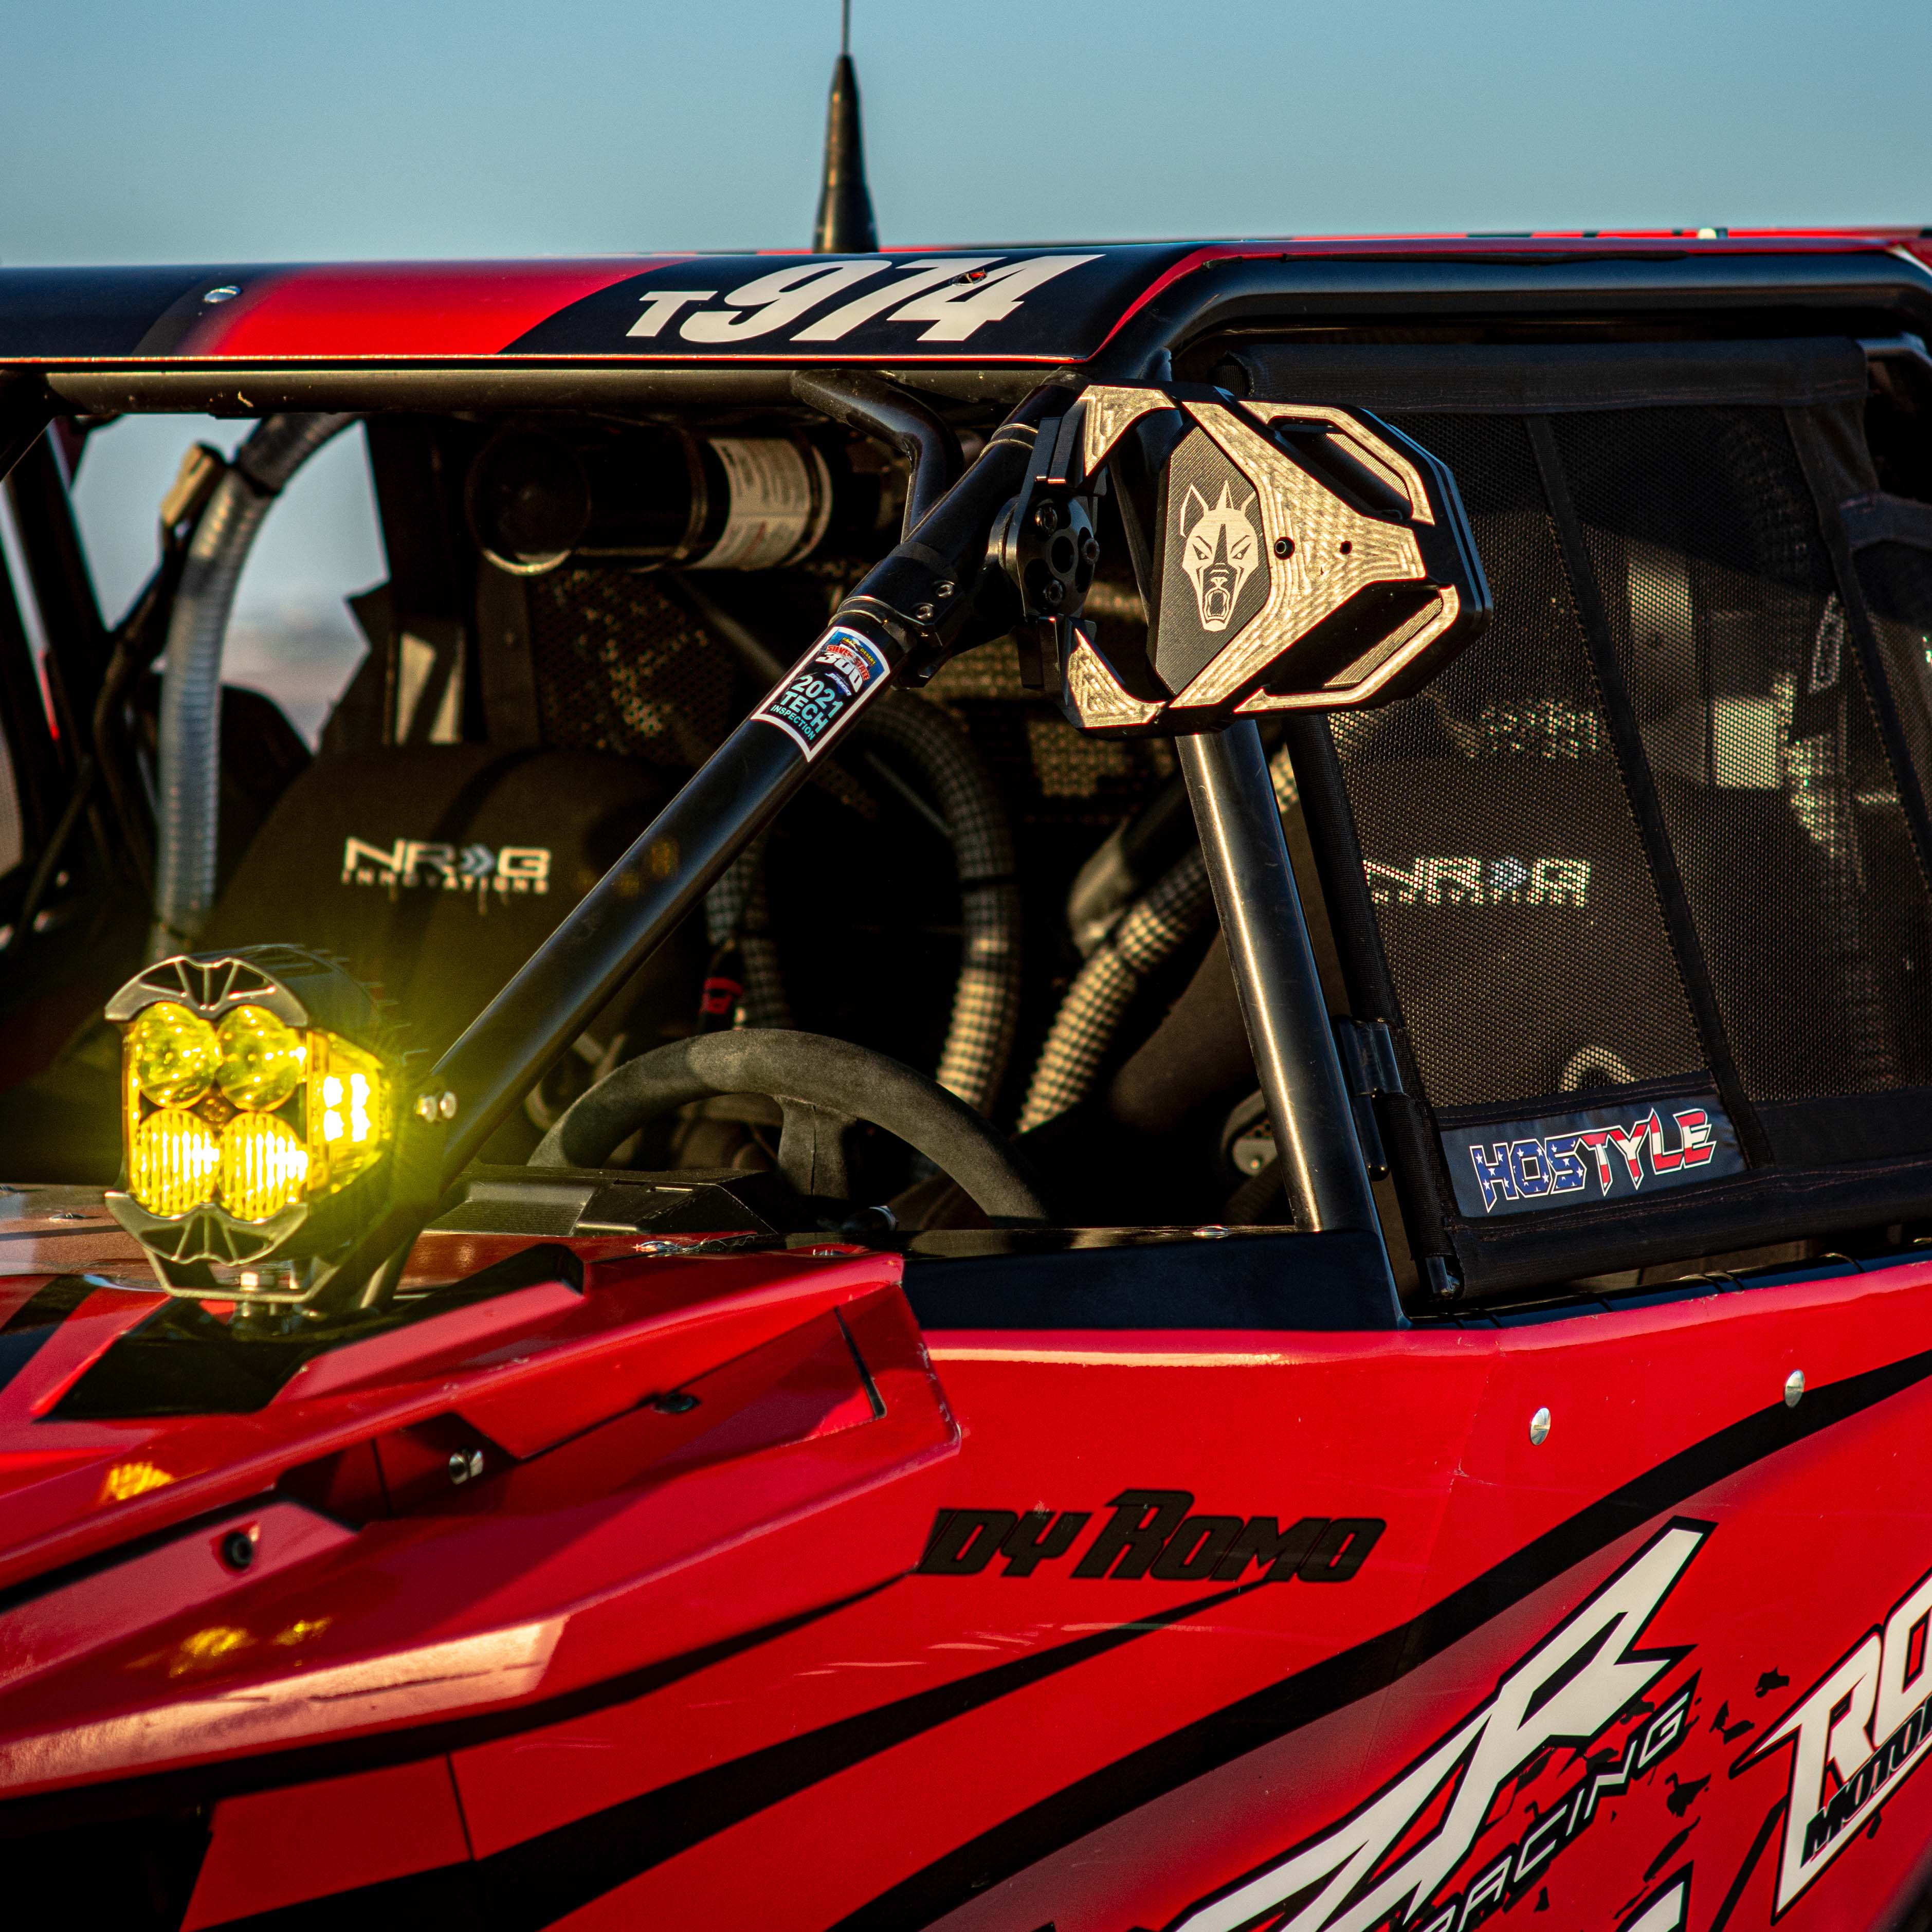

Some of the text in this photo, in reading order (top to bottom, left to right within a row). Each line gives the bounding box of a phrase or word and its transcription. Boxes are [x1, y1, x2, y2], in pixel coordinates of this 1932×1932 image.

[626, 254, 1106, 343] T974
[815, 652, 864, 693] 300
[780, 690, 829, 733] TECH
[791, 675, 843, 718] 2021
[770, 704, 816, 740] INSPECTION
[1469, 1107, 1717, 1213] HOSTYLE
